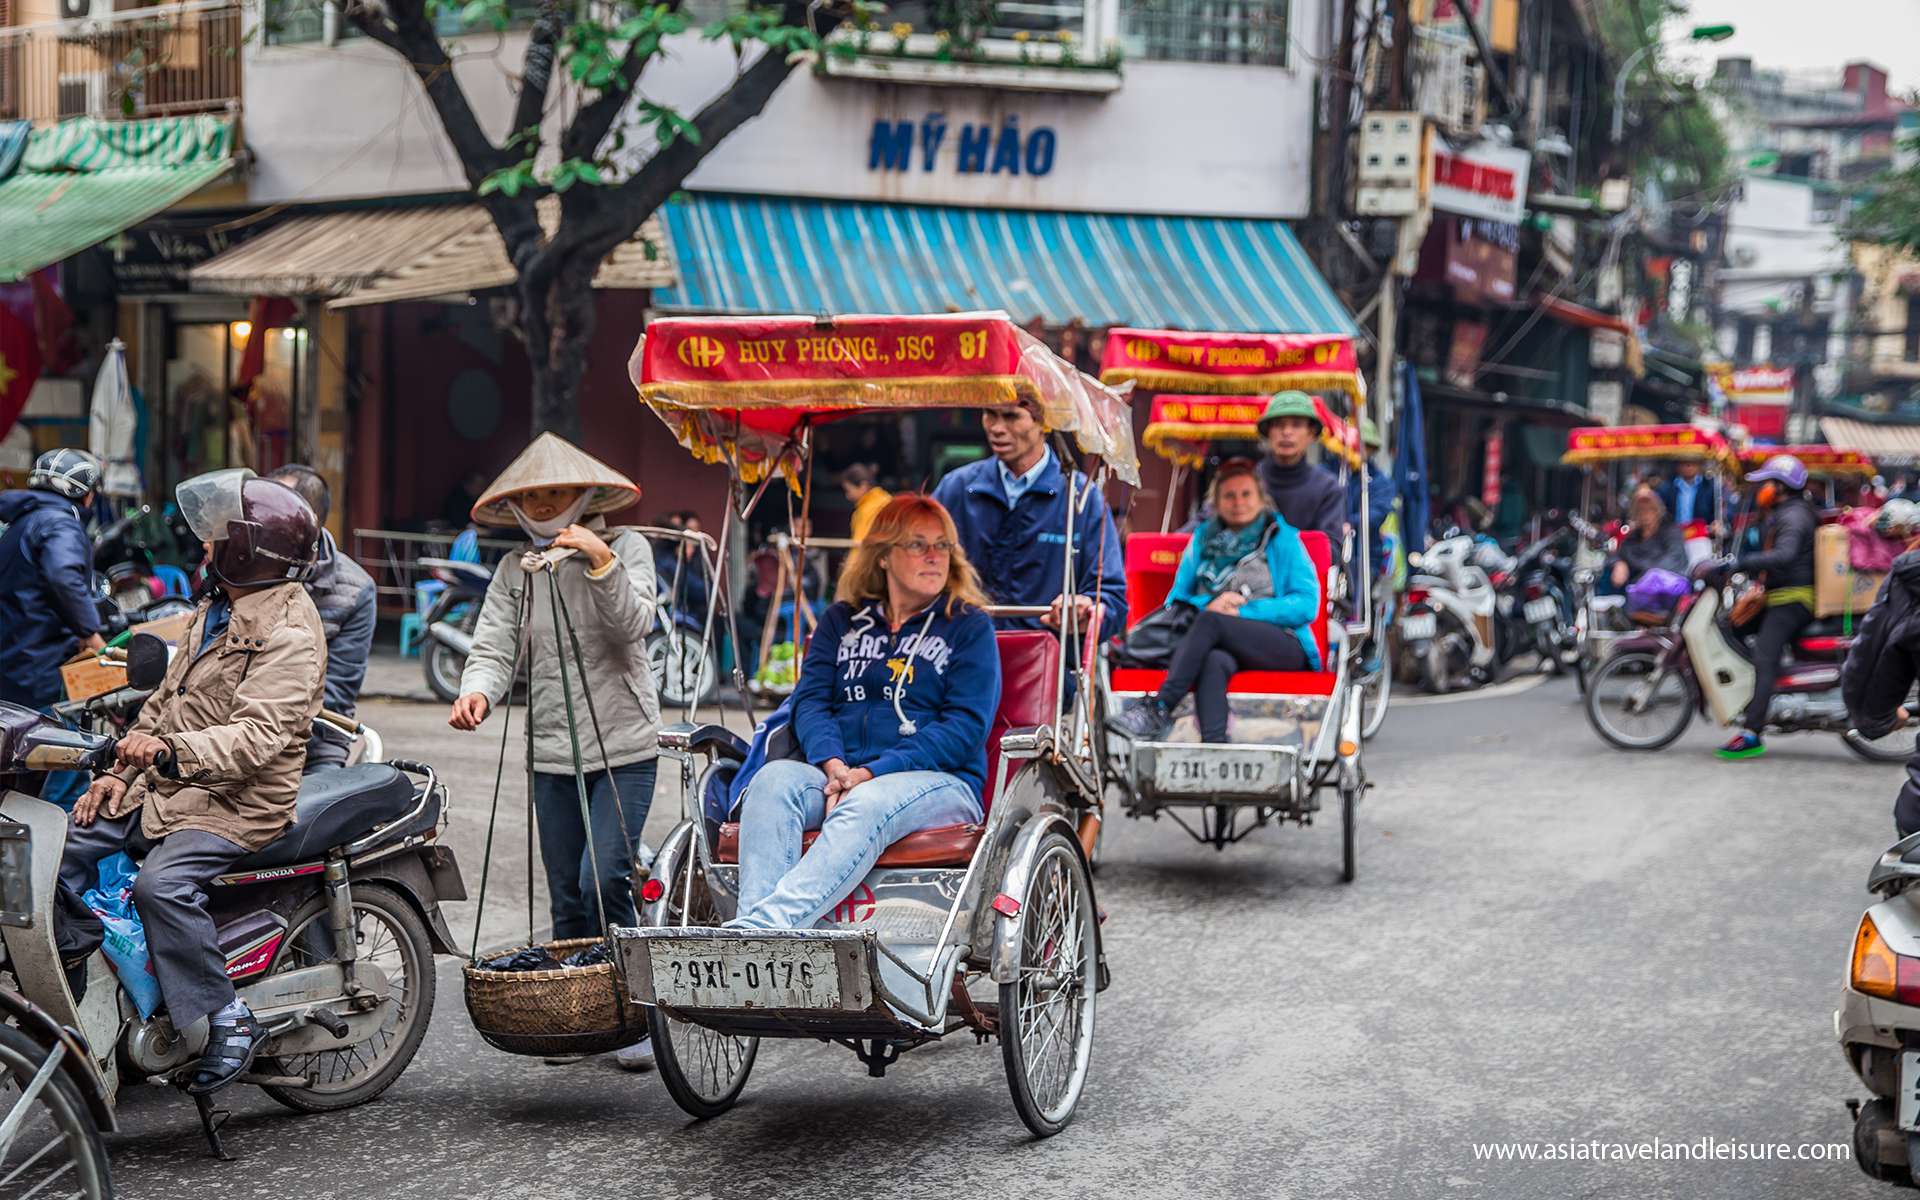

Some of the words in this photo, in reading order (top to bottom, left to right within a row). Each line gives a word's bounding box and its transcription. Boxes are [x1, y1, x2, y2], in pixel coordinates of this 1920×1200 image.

[868, 112, 947, 173] MỸ
[956, 112, 1056, 176] HẢO
[738, 339, 787, 364] HUY
[895, 335, 935, 362] JSC
[959, 330, 988, 360] 81
[843, 660, 872, 680] NY
[255, 868, 295, 880] HONDA
[670, 960, 814, 990] 29XL-0176
